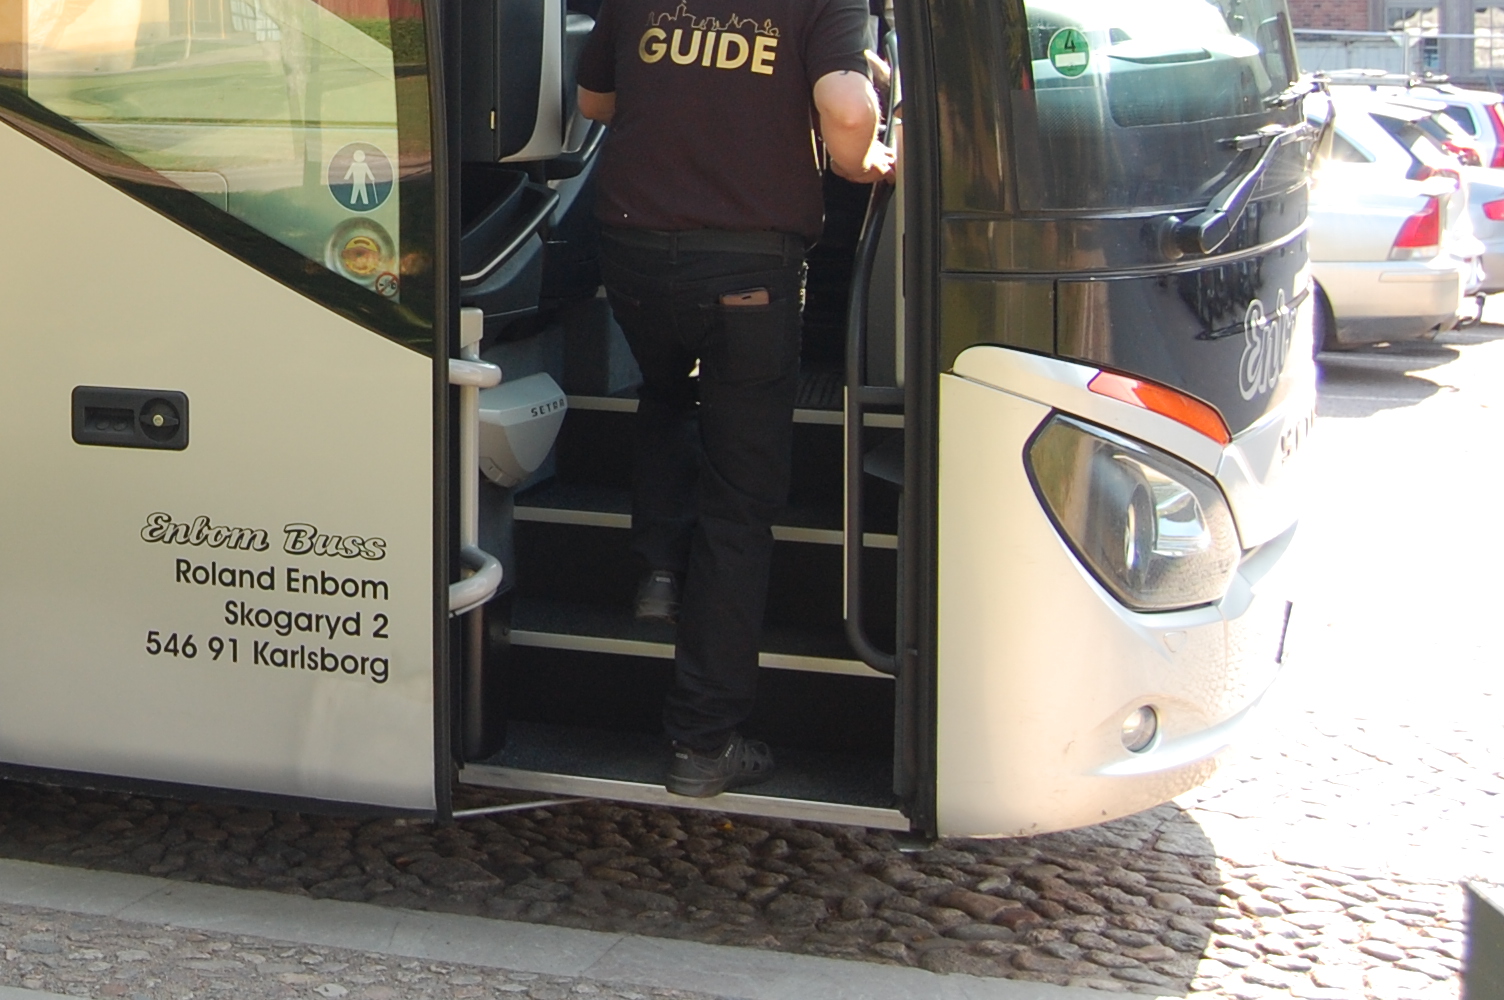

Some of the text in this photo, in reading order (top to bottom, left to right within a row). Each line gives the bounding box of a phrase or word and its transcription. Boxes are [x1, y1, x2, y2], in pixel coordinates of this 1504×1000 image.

[638, 27, 778, 75] GUIDE
[1064, 30, 1076, 53] 4
[530, 398, 565, 418] SETRA
[140, 512, 386, 560] Enbom Buss
[175, 558, 389, 600] Roland Enbom
[224, 600, 389, 640] Skogaryd 2
[146, 630, 389, 684] 546 91 Karlsborg
